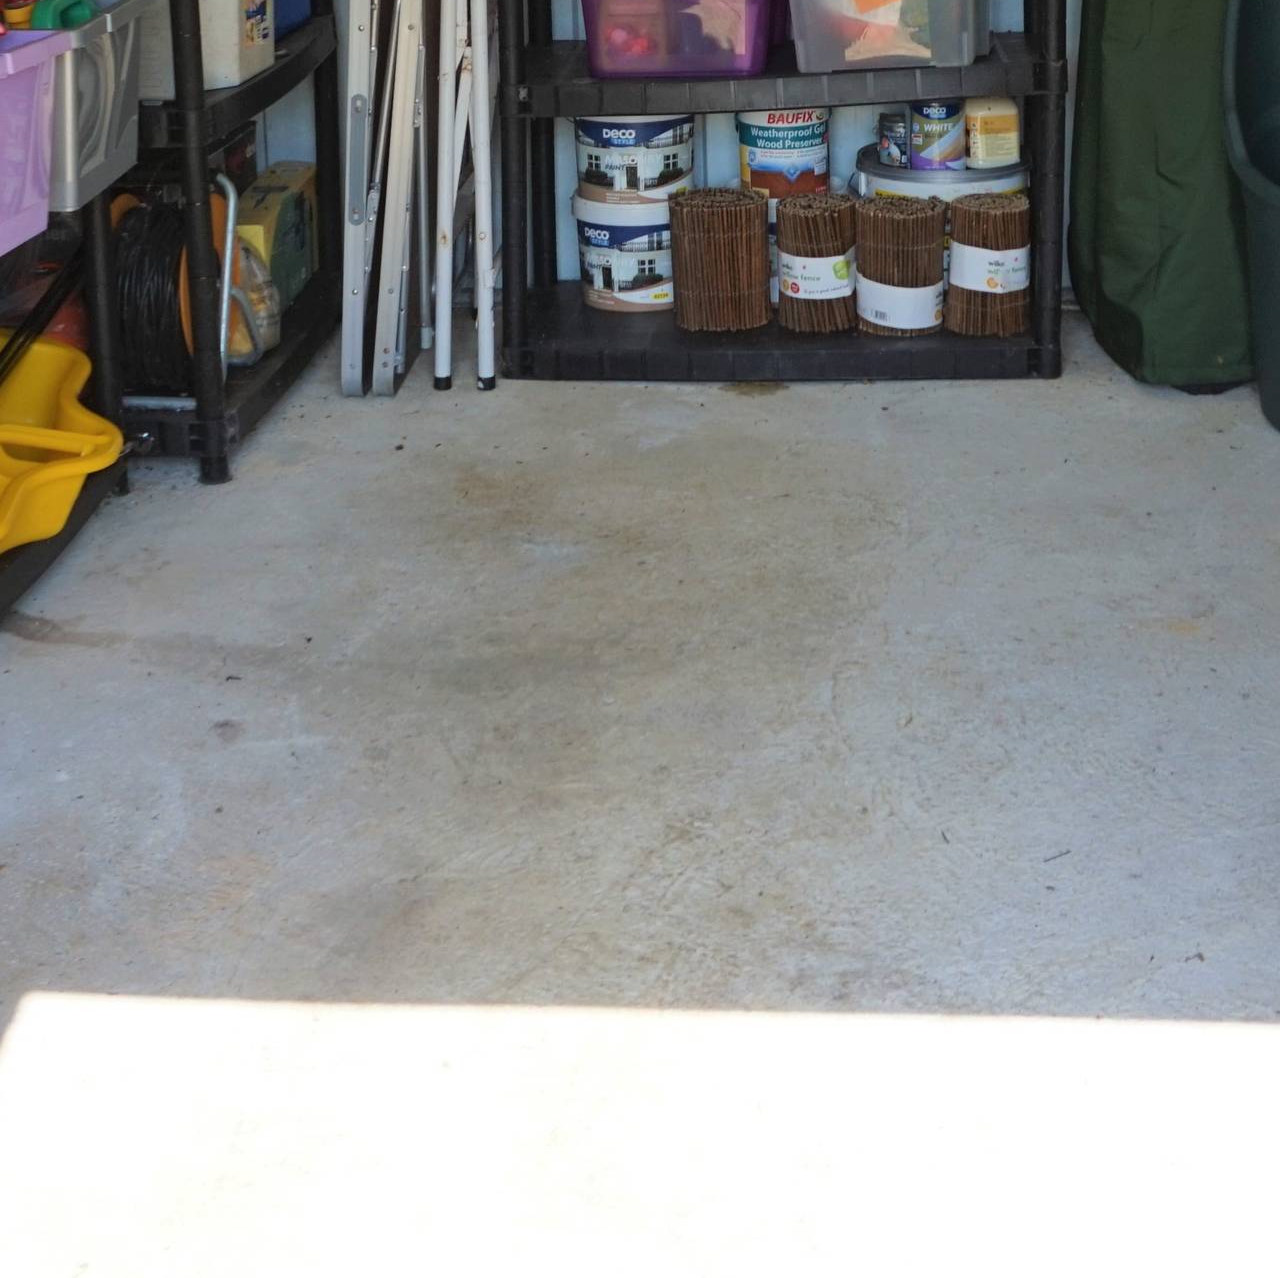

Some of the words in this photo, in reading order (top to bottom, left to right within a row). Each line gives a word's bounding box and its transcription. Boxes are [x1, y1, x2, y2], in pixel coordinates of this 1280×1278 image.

[767, 110, 814, 124] BAUFIX
[750, 126, 813, 139] Weatherproof
[924, 123, 953, 131] WHITE
[757, 138, 783, 148] Wood
